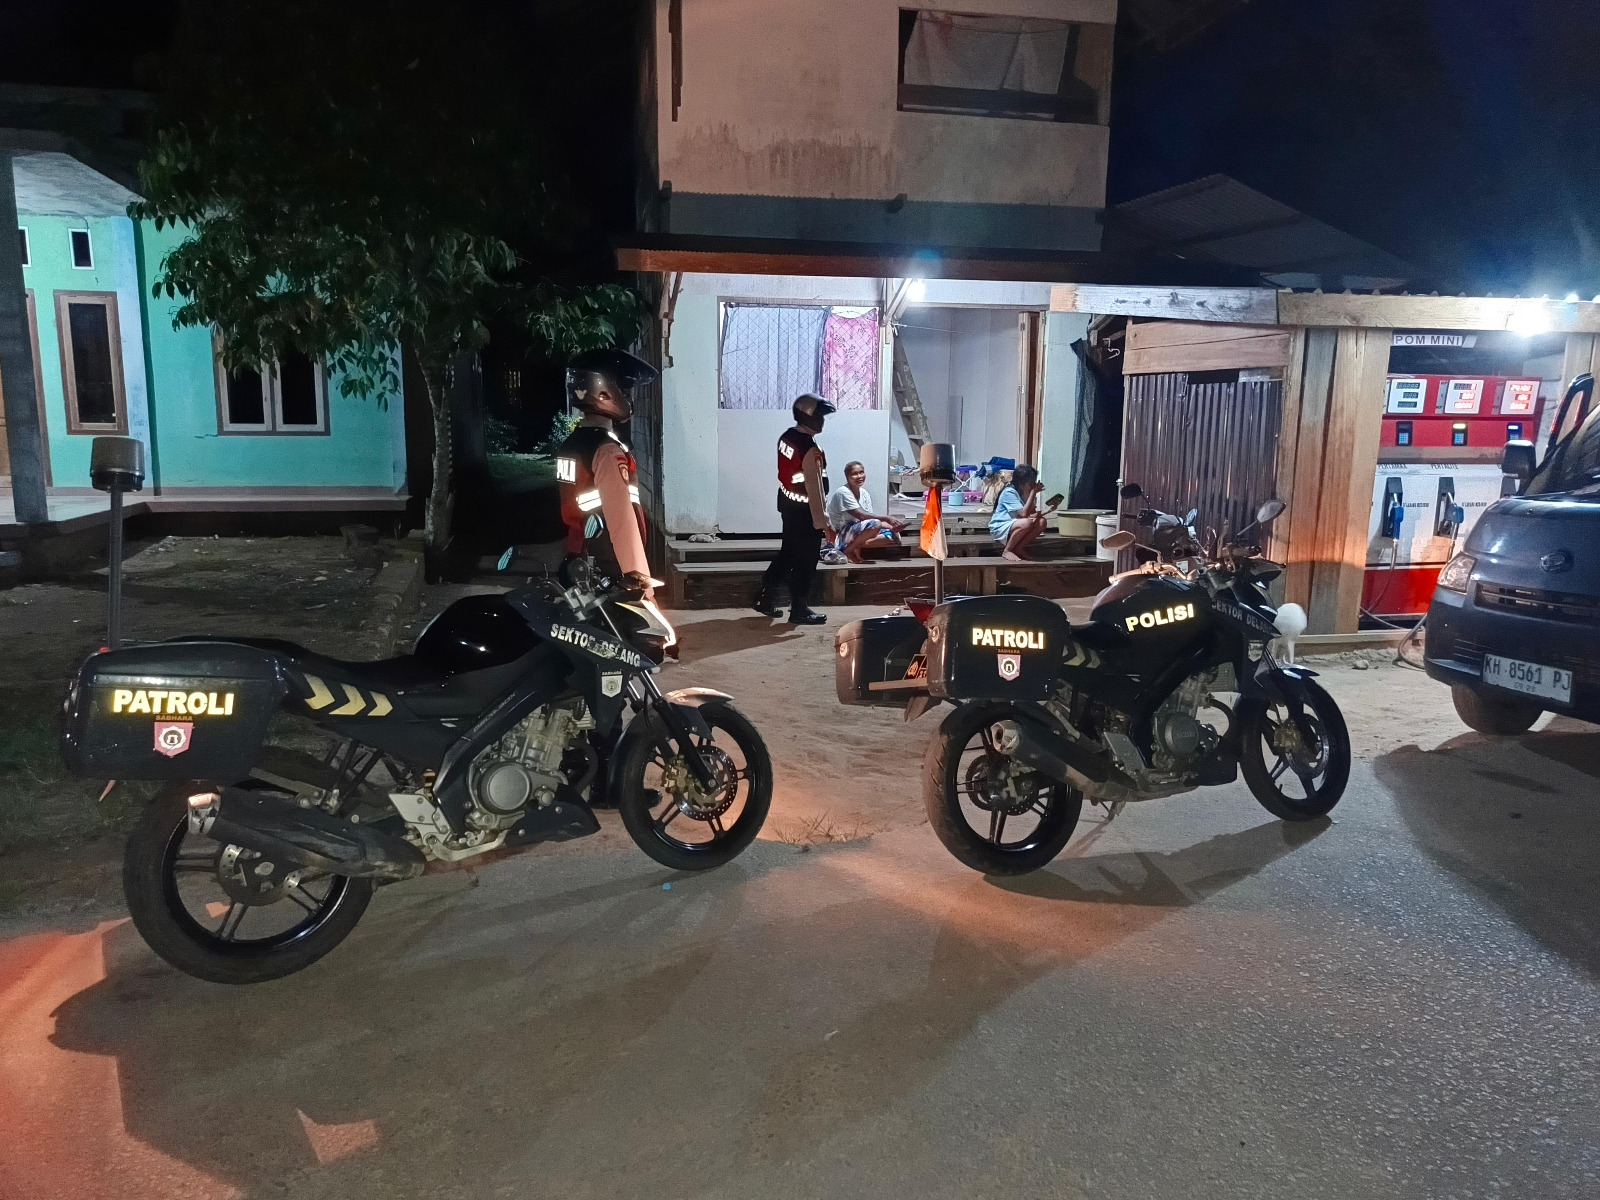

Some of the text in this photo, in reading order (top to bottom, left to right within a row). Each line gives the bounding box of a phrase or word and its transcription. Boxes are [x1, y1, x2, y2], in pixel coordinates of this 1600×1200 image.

[1395, 335, 1461, 346] POM MINI
[1126, 604, 1194, 631] POLISI
[972, 628, 1043, 649] PATROLI
[1484, 656, 1571, 691] KH 8561 PJ
[113, 689, 234, 715] PATROLI
